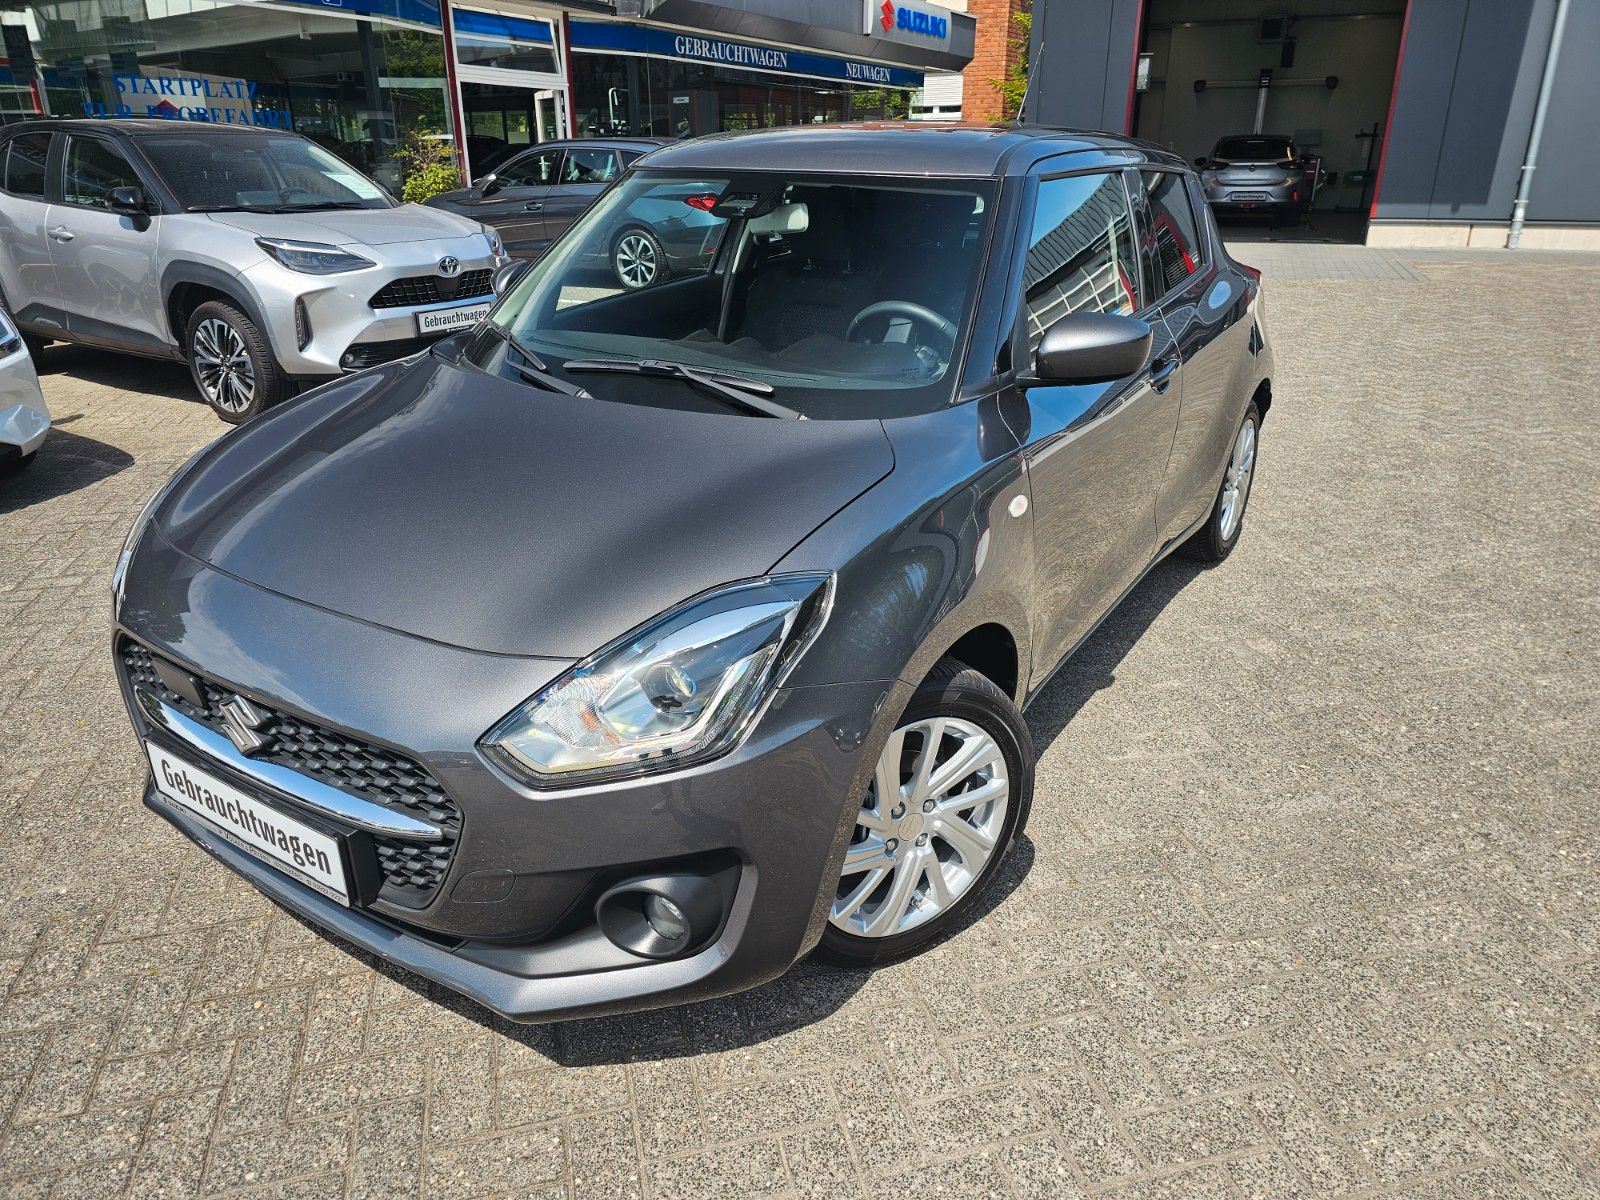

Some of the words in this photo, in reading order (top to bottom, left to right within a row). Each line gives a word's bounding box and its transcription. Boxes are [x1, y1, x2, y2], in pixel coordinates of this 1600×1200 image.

[896, 7, 947, 39] SUZUKI
[674, 36, 788, 69] GEBRAUCHTWAGEN
[845, 62, 891, 82] NEUWAGEN
[112, 73, 260, 99] STARTPLATZ
[81, 102, 131, 119] ZUR
[146, 104, 292, 129] PROBEFAHRT
[424, 309, 487, 328] Gebrauchtwagen
[161, 759, 332, 876] Gebrauchtwagen
